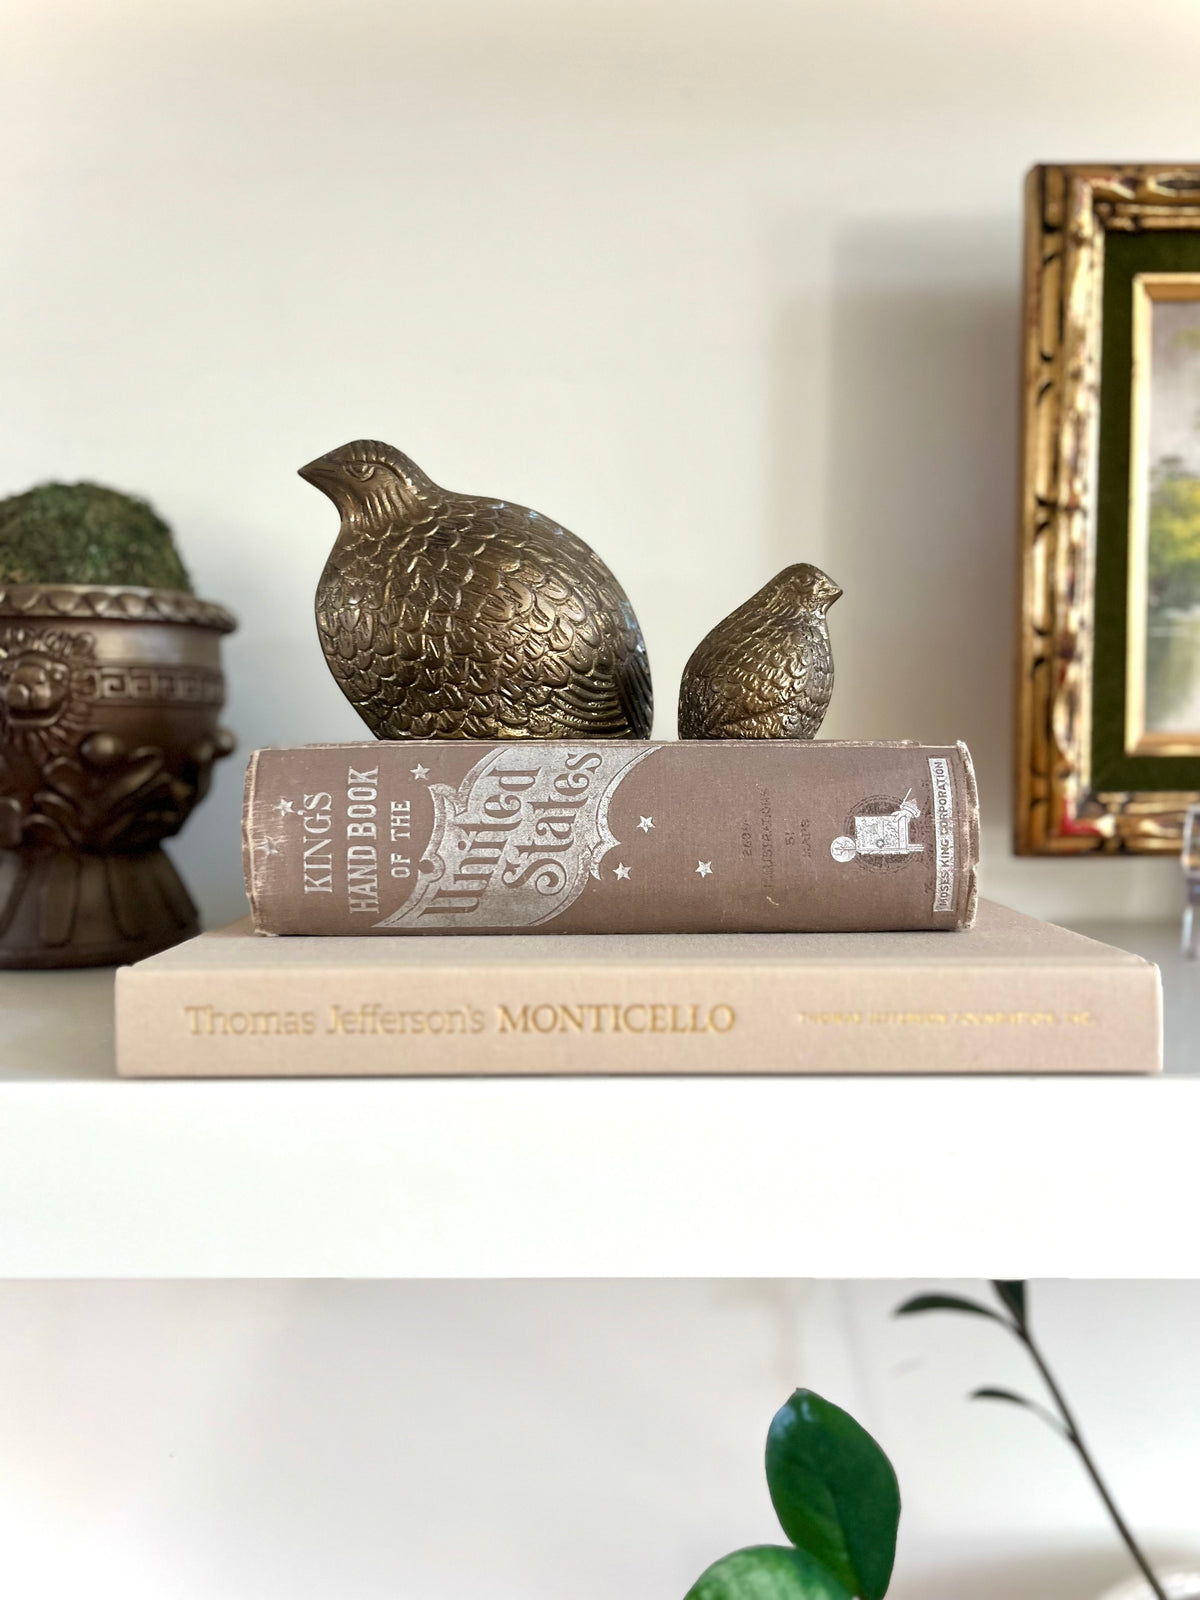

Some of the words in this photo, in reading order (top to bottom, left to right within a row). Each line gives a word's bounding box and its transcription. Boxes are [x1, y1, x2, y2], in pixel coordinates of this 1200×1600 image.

[934, 761, 950, 835] CORPORATION
[391, 800, 411, 841] THE
[502, 753, 602, 897] States
[298, 792, 333, 894] KING'S
[417, 767, 541, 918] United
[940, 838, 950, 868] KING
[391, 853, 411, 878] OF
[939, 872, 950, 906] MOSES
[184, 1004, 316, 1035] Thomas
[326, 1003, 485, 1035] Jefferson's
[497, 1004, 737, 1034] MONTICELLO
